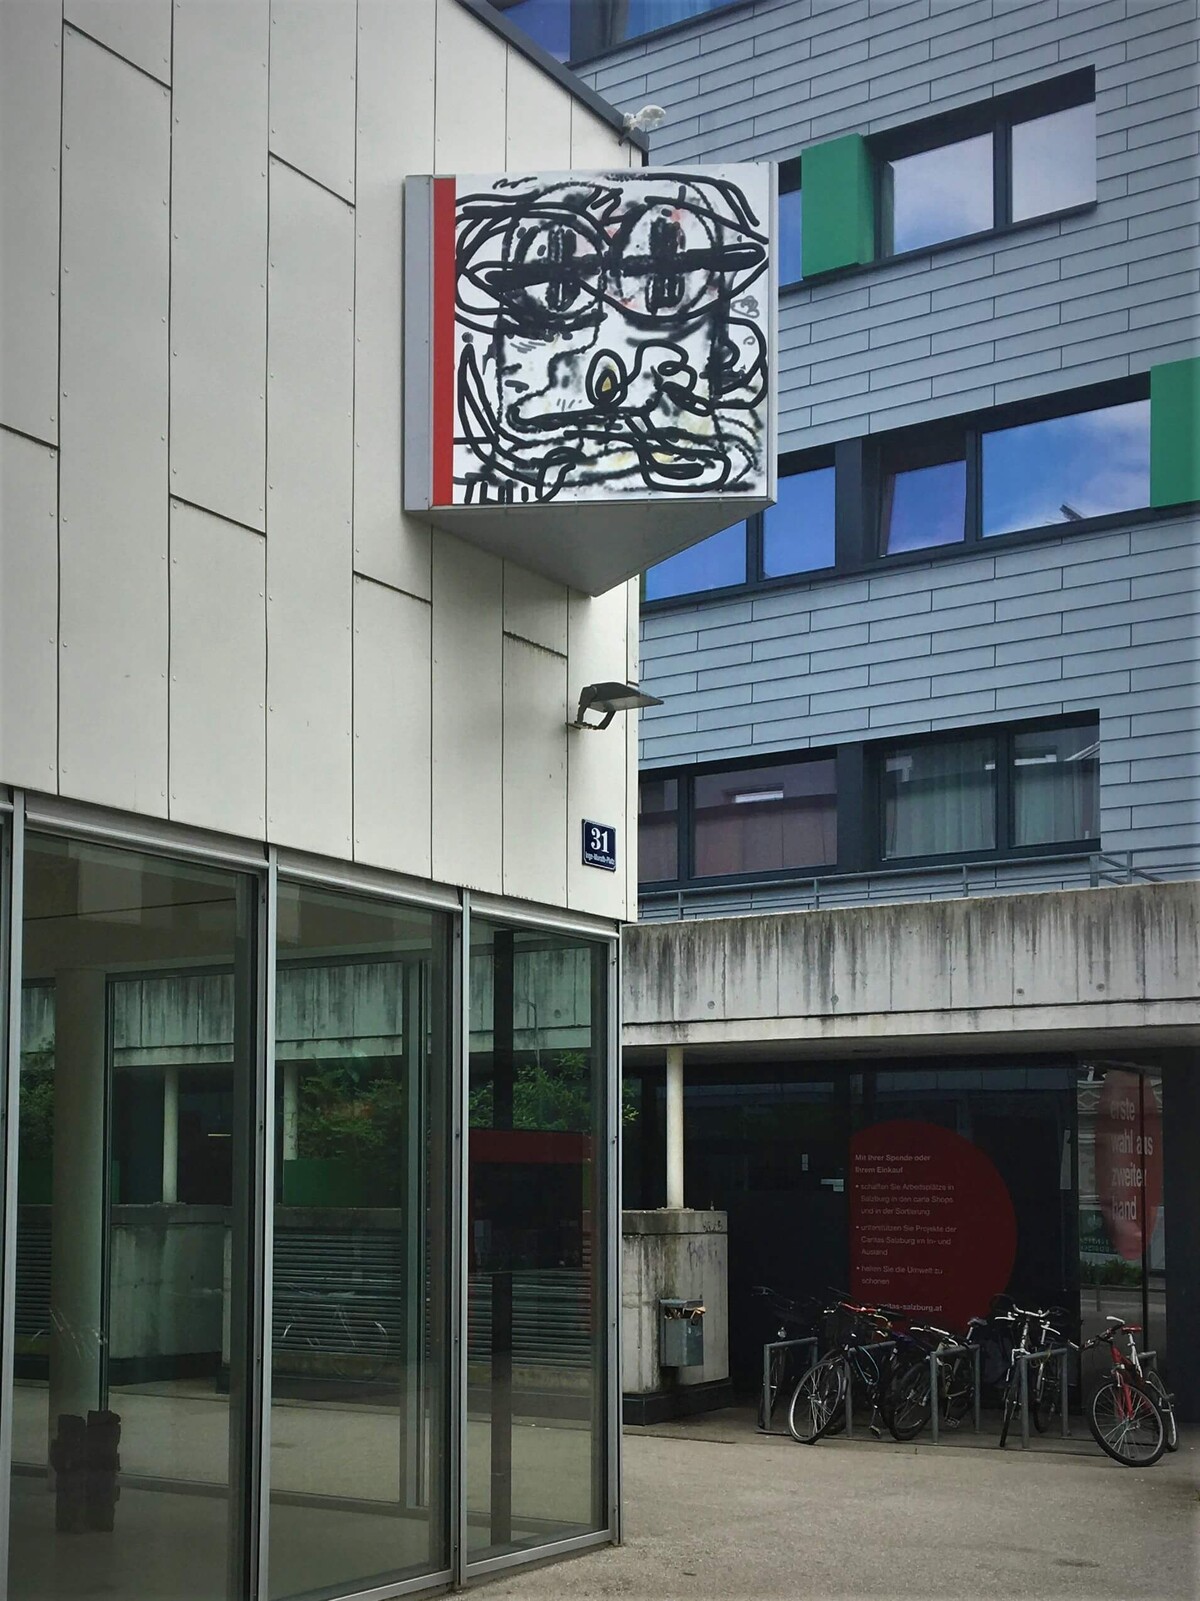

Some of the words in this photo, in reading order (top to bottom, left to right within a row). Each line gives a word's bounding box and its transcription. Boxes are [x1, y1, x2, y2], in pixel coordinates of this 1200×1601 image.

[590, 828, 609, 853] 31
[1110, 1098, 1135, 1121] erste
[1111, 1130, 1133, 1153] wahl
[1112, 1195, 1137, 1220] hand
[916, 1225, 943, 1234] Projekte
[907, 1266, 933, 1274] Umwelt
